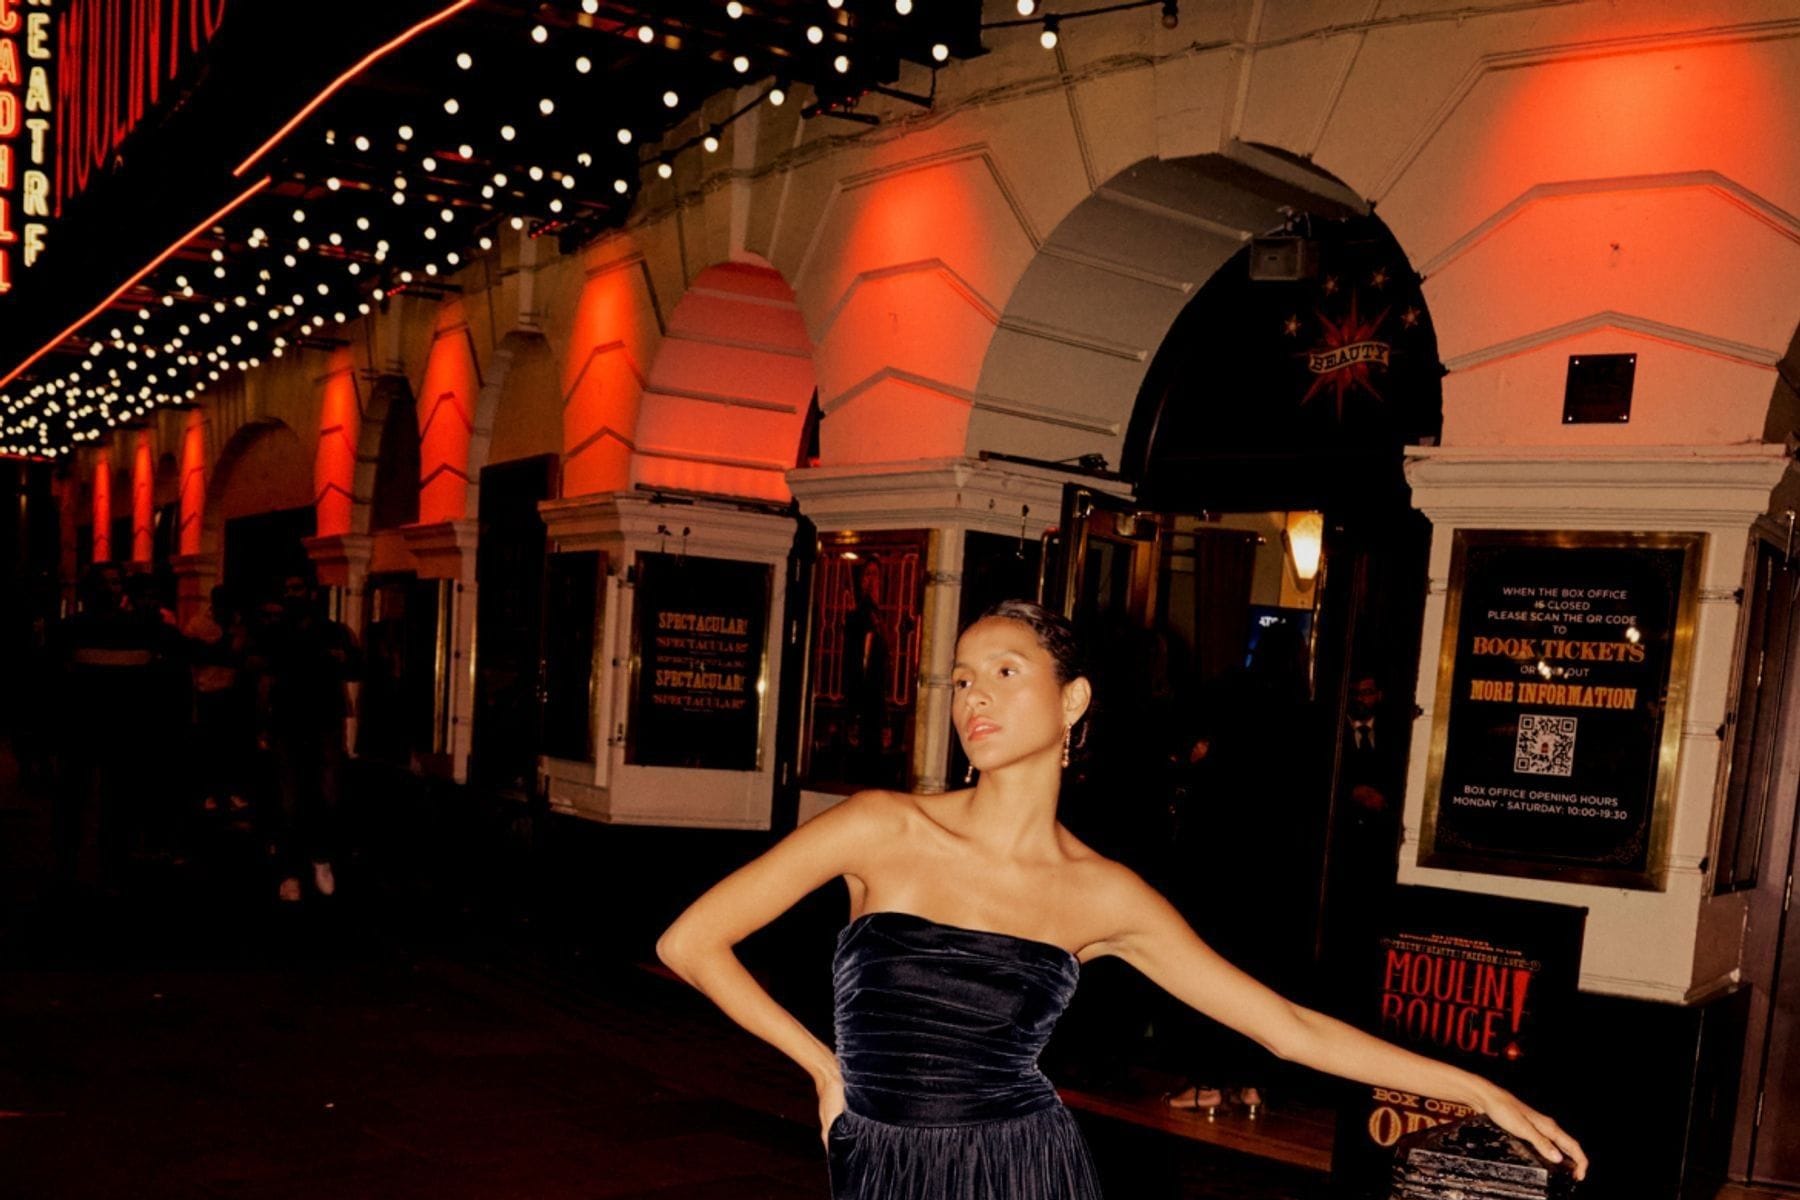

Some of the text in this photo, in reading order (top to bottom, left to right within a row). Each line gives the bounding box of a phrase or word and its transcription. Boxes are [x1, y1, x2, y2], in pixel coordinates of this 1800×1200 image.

[1311, 343, 1387, 371] BEAUTY
[1503, 587, 1628, 600] WHEN THE BOX OFFICE
[1547, 601, 1591, 611] CLOSED
[1487, 611, 1637, 625] PLEASE SCAN THE QR CODE
[1552, 625, 1567, 635] TO
[1472, 636, 1646, 663] BOOK TICKETS
[1520, 665, 1536, 674] OR
[1470, 680, 1638, 710] MORE INFORMATION
[1452, 796, 1497, 808] MONDAY
[1506, 802, 1565, 815] SATURDAY:
[1464, 785, 1619, 807] BOX OFFICE OPENING HOURS
[1384, 949, 1508, 1009] MOULIN
[1372, 1088, 1420, 1108] BOX
